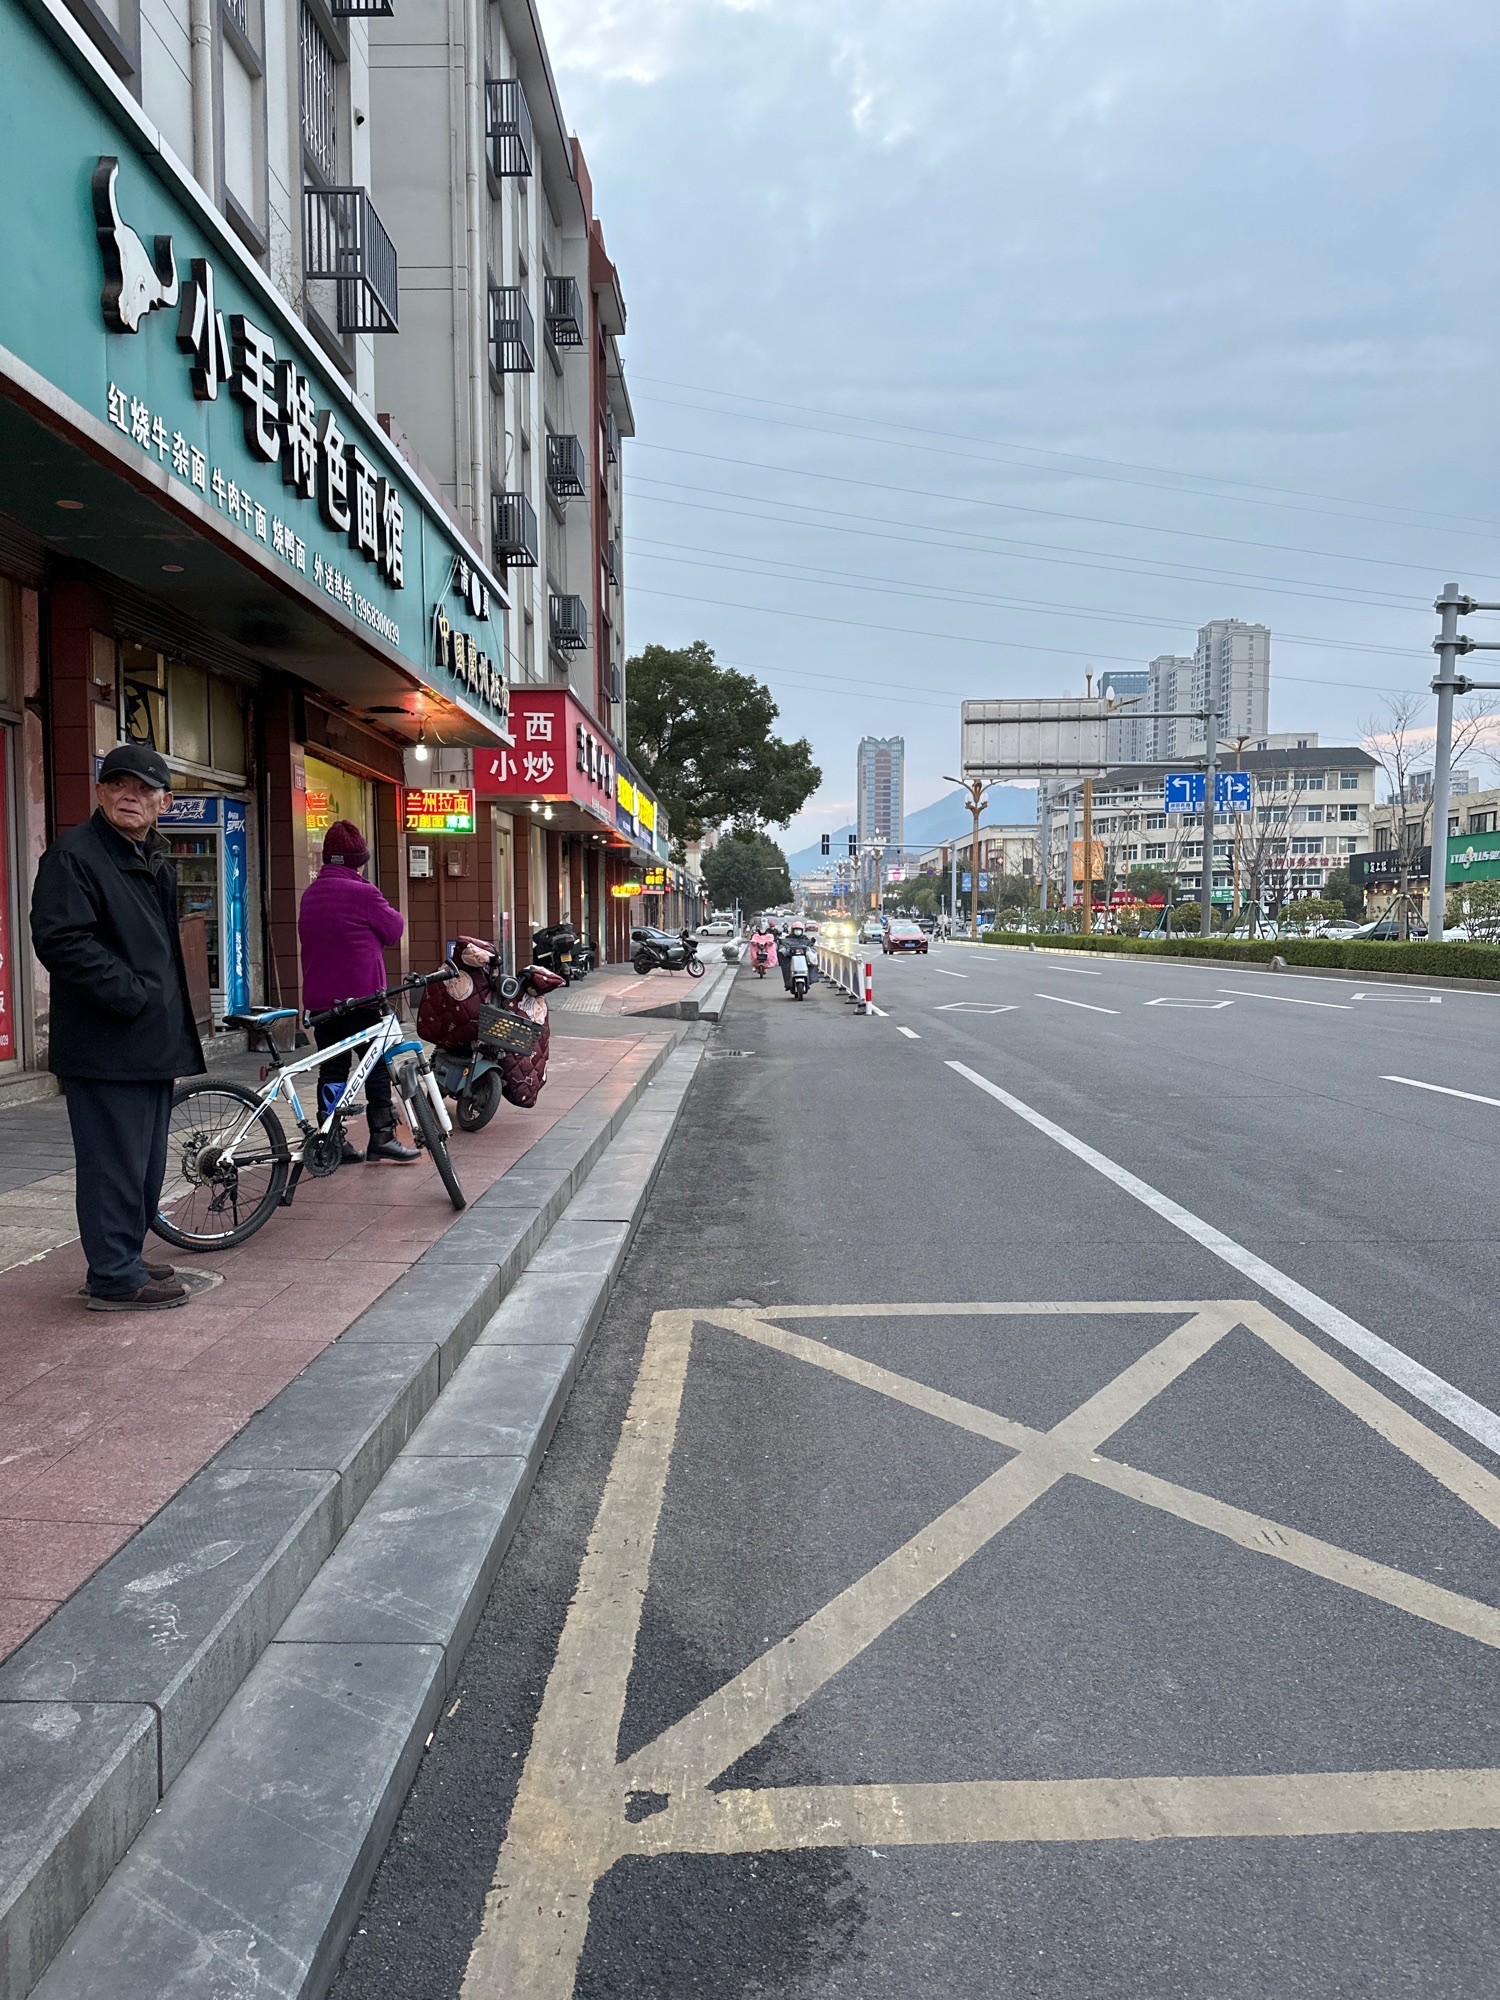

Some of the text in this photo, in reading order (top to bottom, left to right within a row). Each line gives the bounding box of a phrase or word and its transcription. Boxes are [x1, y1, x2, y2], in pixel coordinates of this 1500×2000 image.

[180, 258, 404, 590] 小毛特色面馆
[107, 381, 400, 646] 红烧牛杂面 牛肉干面 烧鸭面 外送热线 13968300039
[489, 750, 555, 784] 小炒
[577, 722, 614, 799] 江西小炒
[406, 792, 470, 814] 兰州拉面
[406, 814, 445, 828] 刀削面
